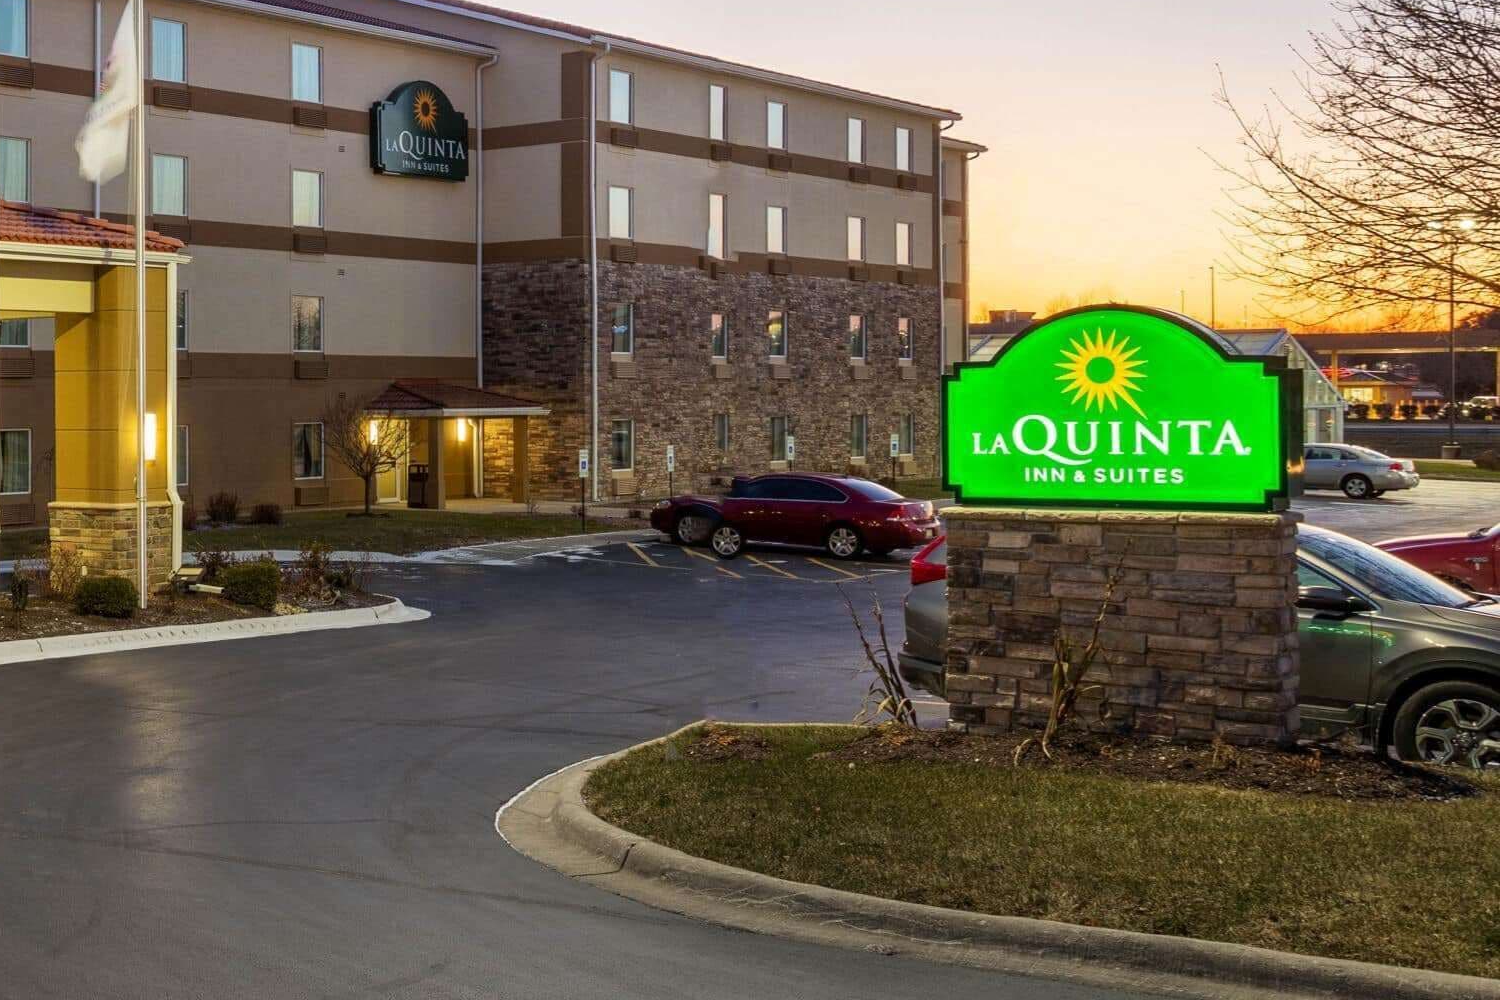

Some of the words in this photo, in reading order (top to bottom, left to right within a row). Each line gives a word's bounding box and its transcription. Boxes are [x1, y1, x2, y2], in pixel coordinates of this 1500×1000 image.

[386, 138, 399, 153] LA
[400, 130, 466, 160] QUINTA
[403, 159, 416, 169] INN
[423, 162, 450, 174] SUITES
[972, 433, 1011, 455] LA
[1012, 414, 1250, 466] QUINTA
[1024, 467, 1065, 482] INN
[1073, 470, 1086, 483] &
[1094, 467, 1185, 484] SUITES
